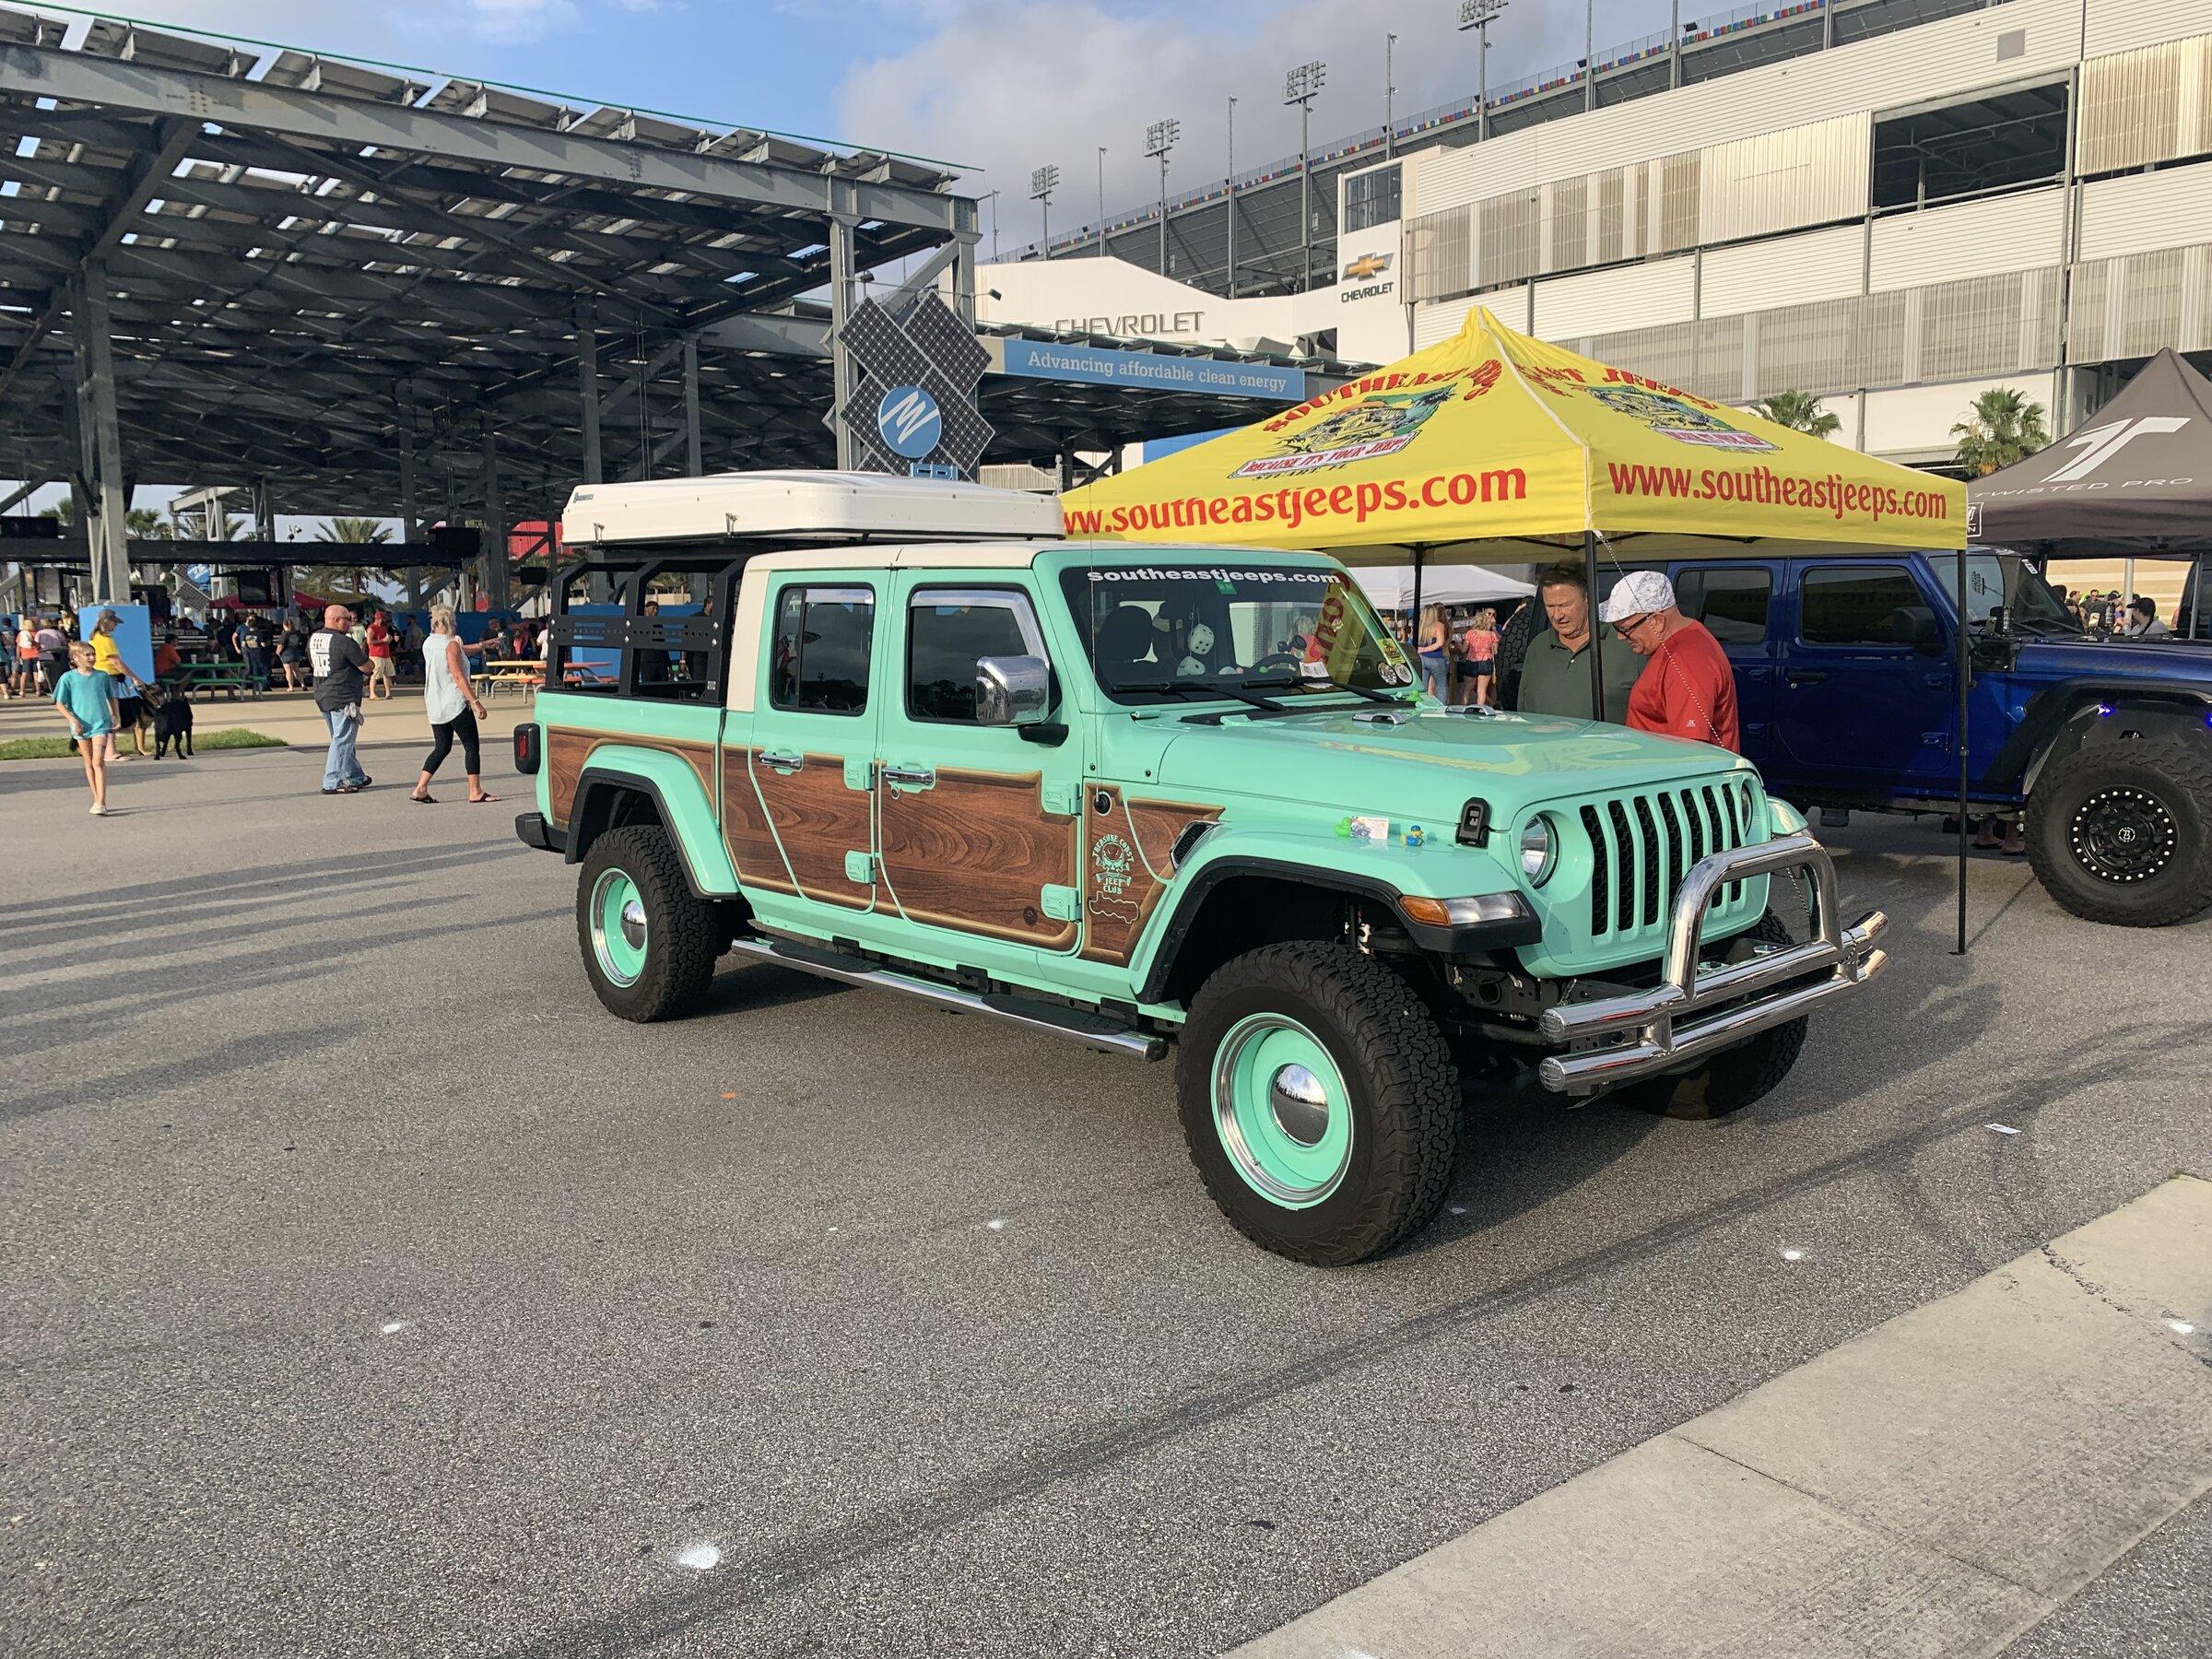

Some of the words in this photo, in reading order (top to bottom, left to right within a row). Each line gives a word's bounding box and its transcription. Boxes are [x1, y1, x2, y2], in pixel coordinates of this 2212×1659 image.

[1340, 281, 1394, 303] CHEVROLET
[1054, 311, 1206, 336] CHEVROLET
[1028, 350, 1114, 377] Advancing
[1119, 360, 1194, 382] affordable
[1198, 369, 1236, 385] clean
[1239, 375, 1288, 393] energy
[1607, 462, 1947, 522] www.southeastjeeps.com
[1975, 482, 2109, 499] TWISTED
[2122, 477, 2194, 488] PRO
[1087, 567, 1342, 584] southeastjeeps.com
[1091, 834, 1119, 857] TREASURE
[1119, 839, 1135, 863] COAST
[1102, 885, 1123, 895] CLUB
[1103, 877, 1123, 888] JEEP
